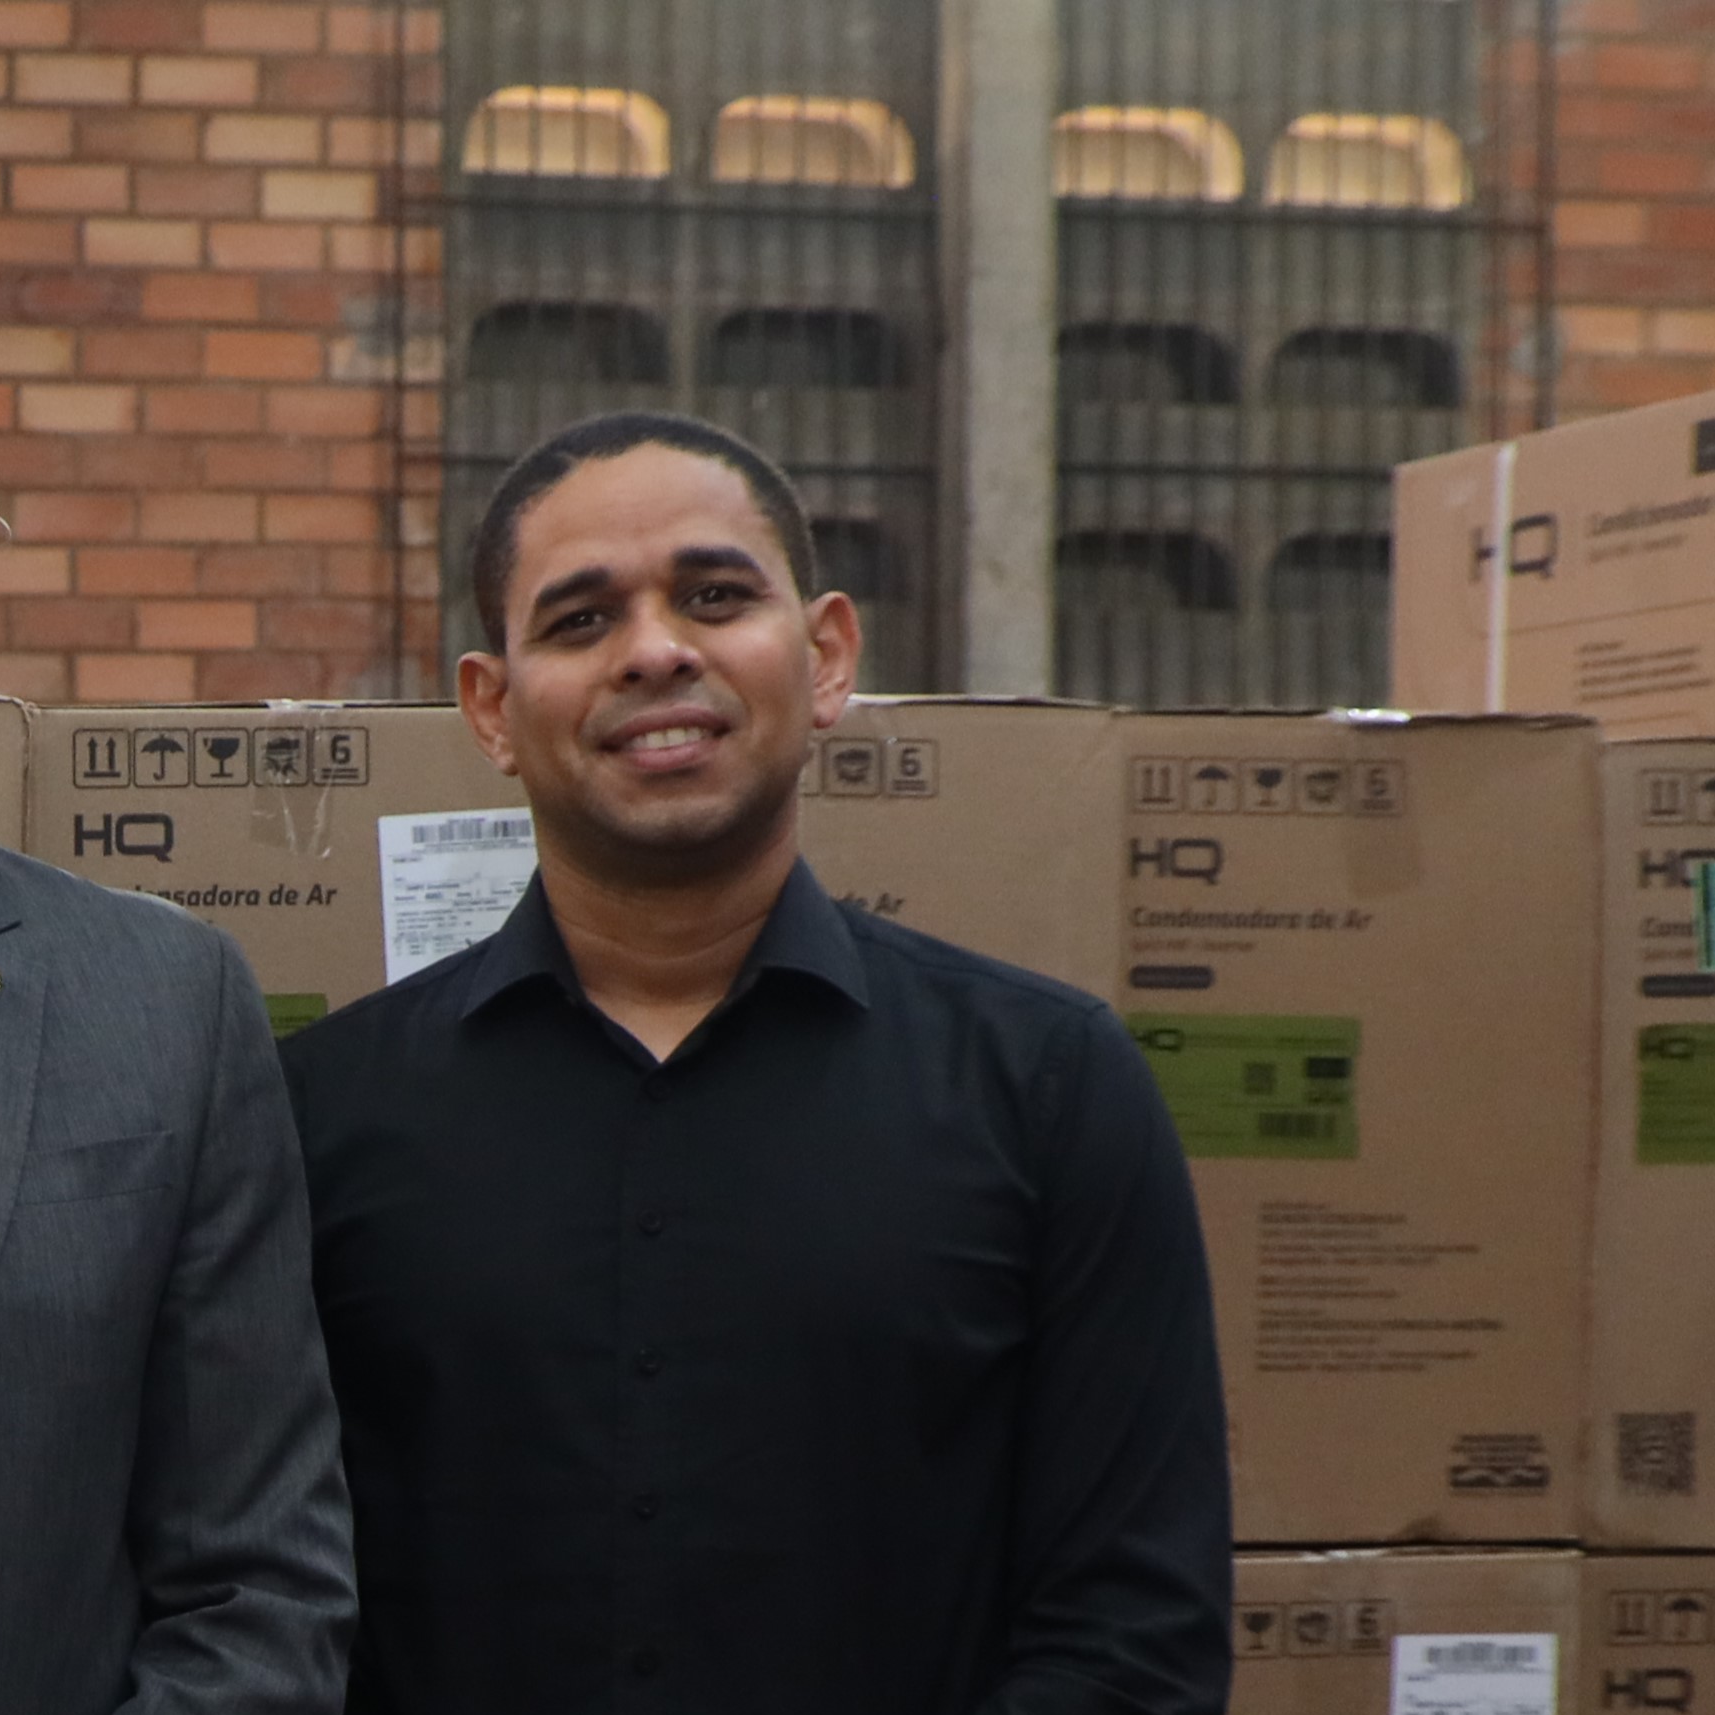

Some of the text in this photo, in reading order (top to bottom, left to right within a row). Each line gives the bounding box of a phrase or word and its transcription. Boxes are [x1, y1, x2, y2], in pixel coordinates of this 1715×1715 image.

[331, 734, 351, 764] 6
[900, 746, 921, 777] 6
[73, 814, 174, 863] HQ
[1129, 838, 1223, 886] HQ
[269, 884, 338, 906] de Ar
[873, 891, 905, 914] Ar
[1132, 907, 1372, 930] Condensadora de Ar
[1603, 1668, 1695, 1714] HQ
